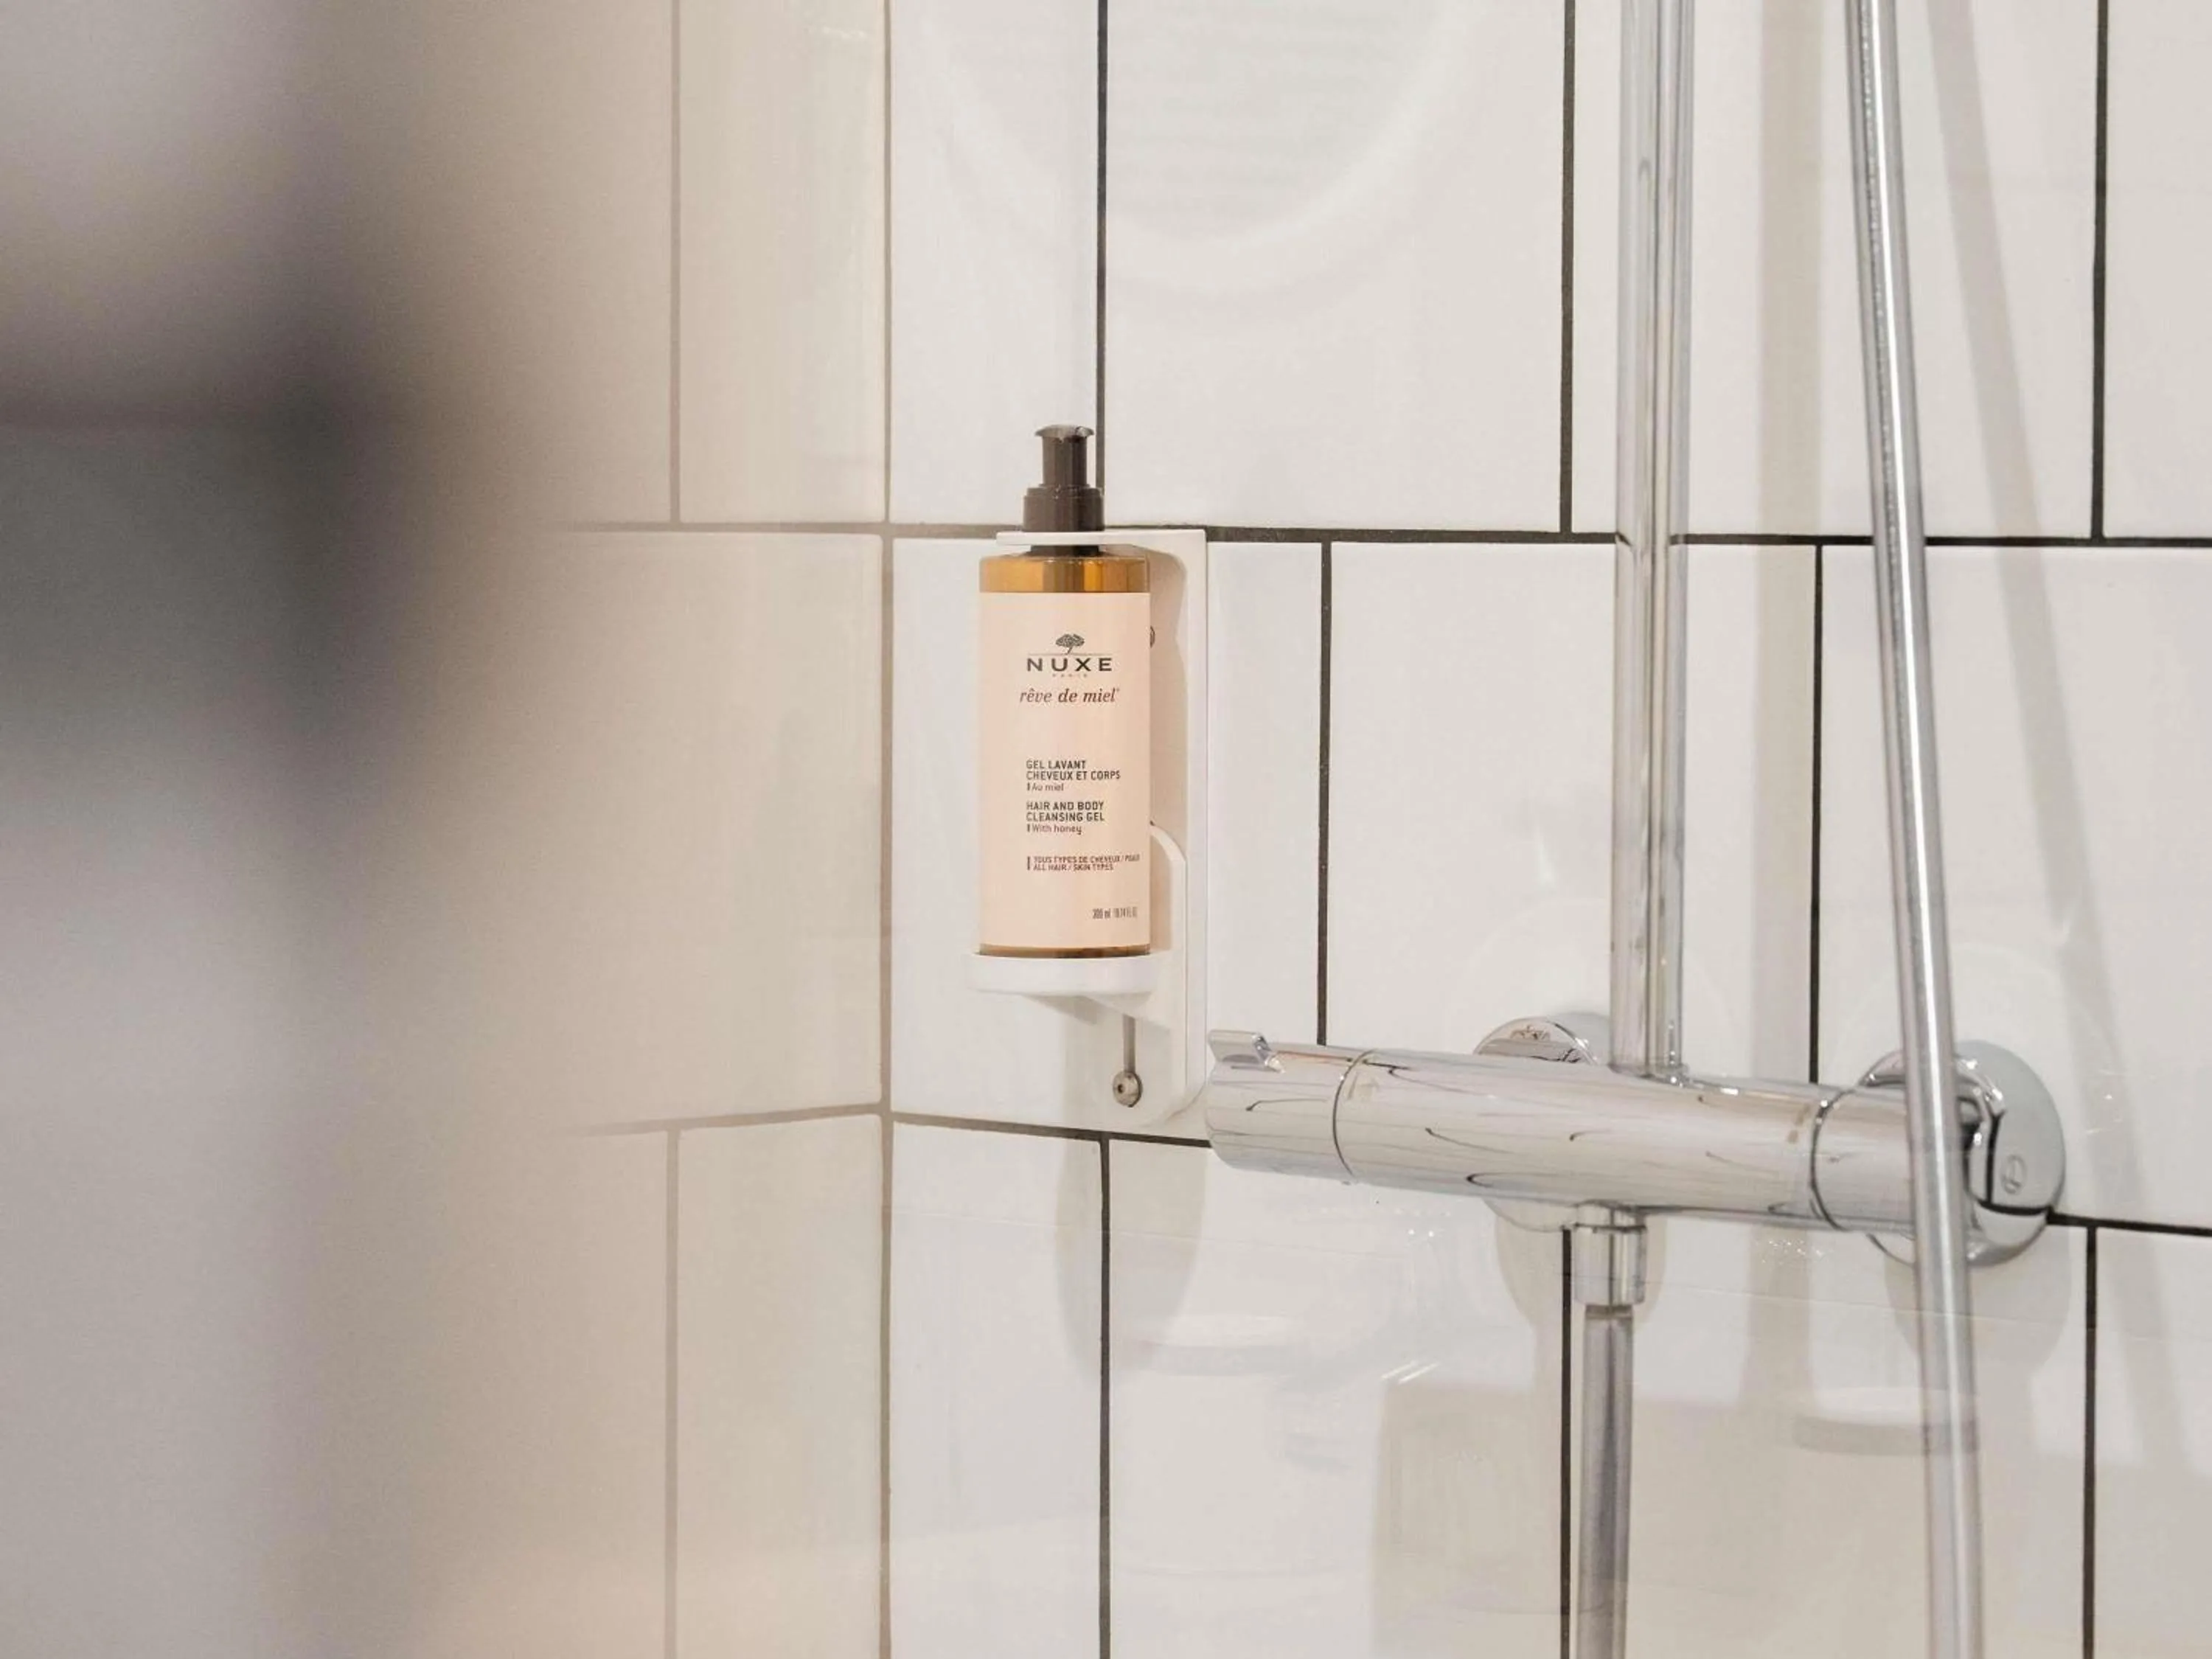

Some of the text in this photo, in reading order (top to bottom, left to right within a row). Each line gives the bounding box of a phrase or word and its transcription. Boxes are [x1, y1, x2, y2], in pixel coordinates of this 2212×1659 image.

[1026, 657, 1113, 672] NUXE
[1020, 686, 1053, 703] rêve
[1058, 687, 1077, 703] de
[1026, 759, 1086, 770] GEL LAVANT
[1026, 770, 1121, 781] CHEVEUX ET CORPS
[1045, 782, 1064, 791] miel
[1026, 801, 1105, 810] HAIR AND BODY
[1026, 812, 1105, 822] CLEANSING GEL
[1032, 824, 1082, 835] With honey
[1074, 863, 1091, 872] SKIN
[1092, 863, 1114, 871] TYPES
